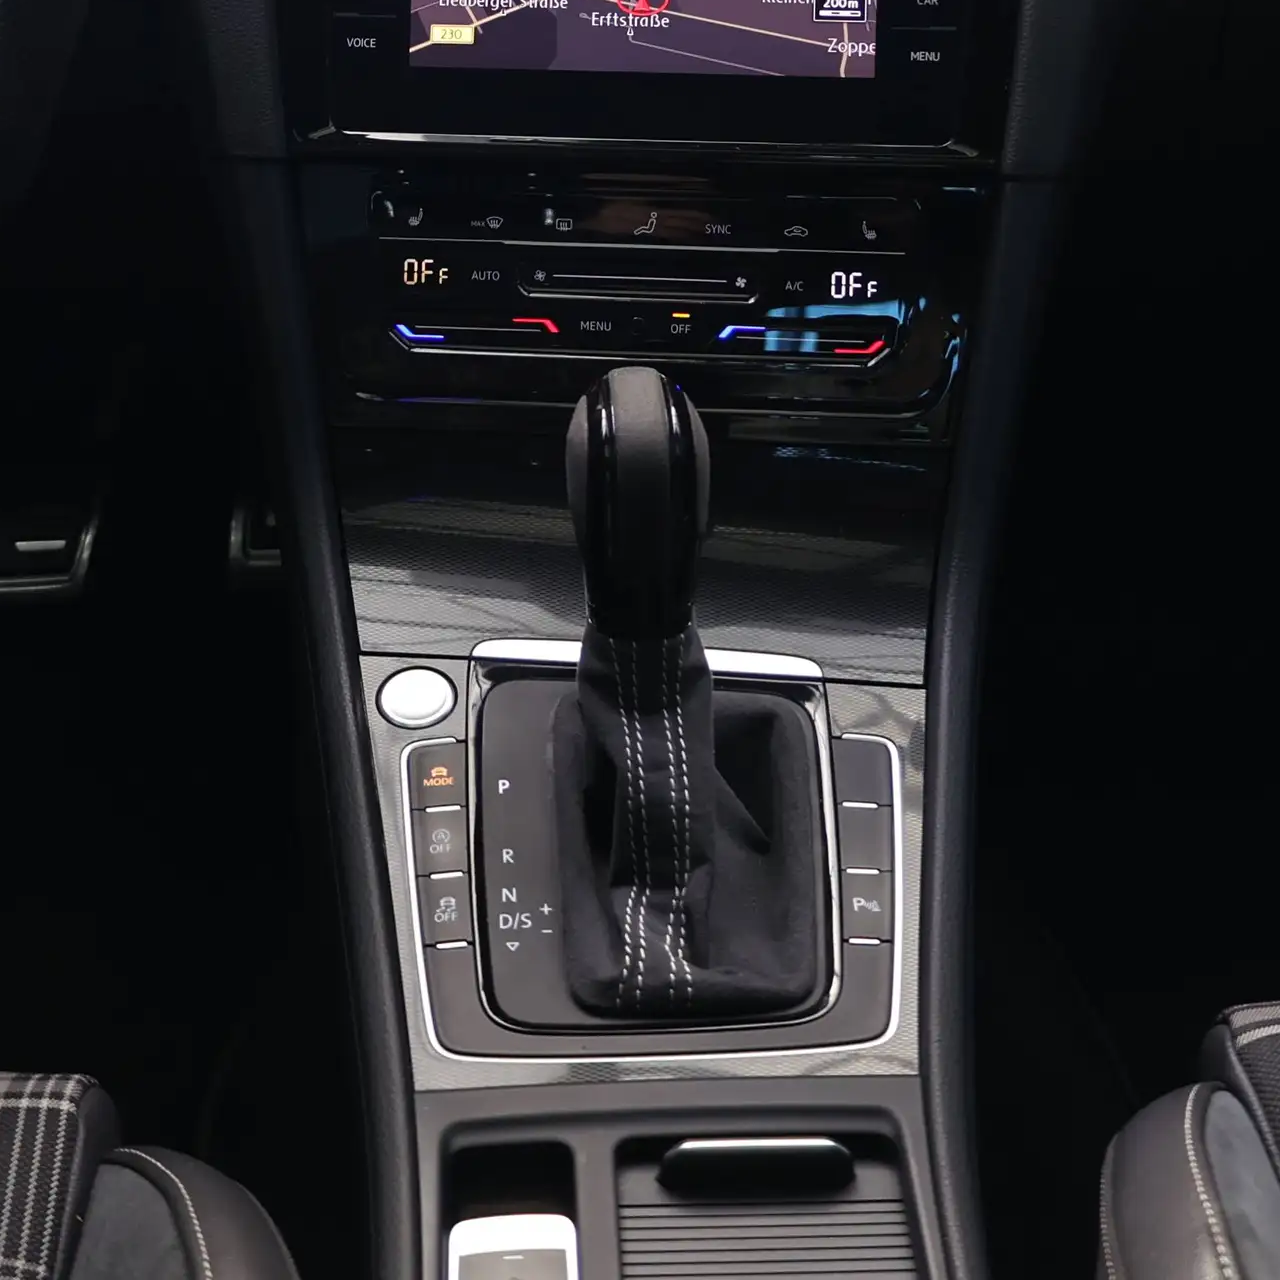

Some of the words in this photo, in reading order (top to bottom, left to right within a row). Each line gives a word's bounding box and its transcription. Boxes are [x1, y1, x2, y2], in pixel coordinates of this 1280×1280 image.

[591, 12, 670, 28] Erftstraße
[440, 28, 463, 40] 230
[346, 37, 377, 49] VOICE
[910, 51, 941, 63] MENU
[471, 220, 486, 228] MAX
[705, 224, 732, 235] SYNC
[471, 270, 501, 282] AUTO
[785, 280, 805, 293] A/C
[580, 320, 613, 332] MENU
[670, 323, 692, 335] OFF
[498, 780, 510, 794] P
[429, 844, 452, 854] OFF
[502, 849, 514, 864] R
[502, 888, 517, 903] N
[434, 911, 458, 923] OFF
[498, 913, 533, 930] D/S
